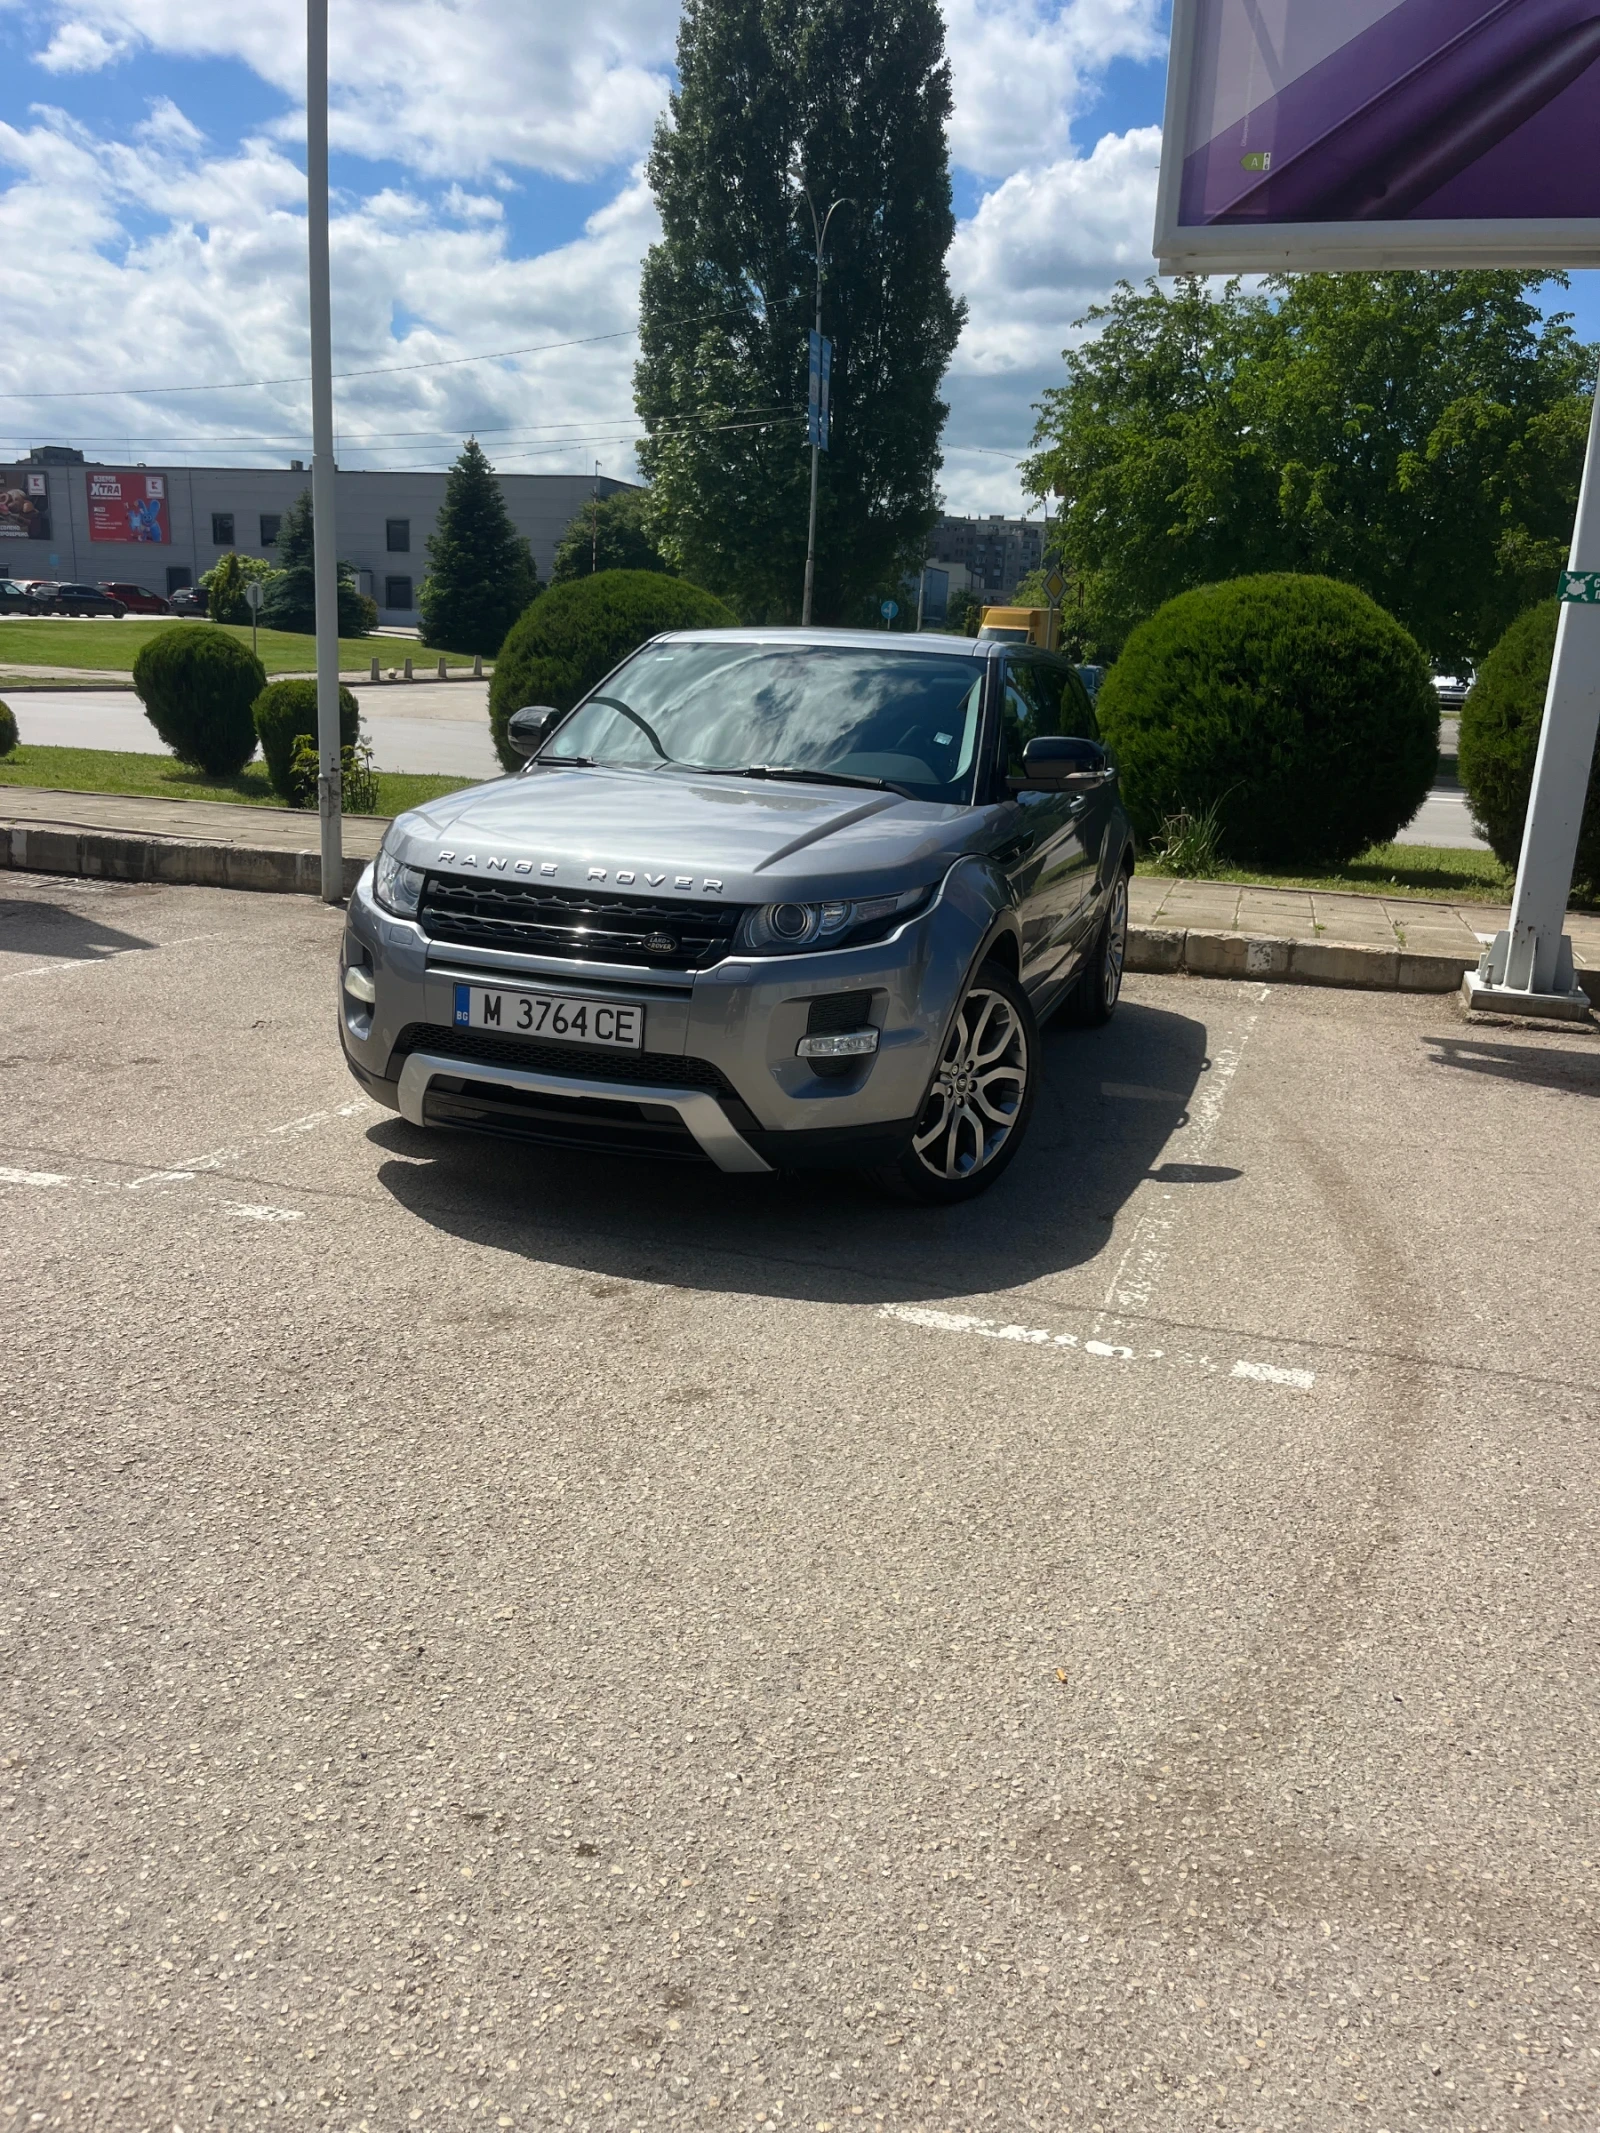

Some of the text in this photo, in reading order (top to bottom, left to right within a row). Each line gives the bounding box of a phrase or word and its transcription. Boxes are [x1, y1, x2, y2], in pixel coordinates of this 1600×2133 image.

[1251, 157, 1258, 167] A
[438, 850, 724, 894] RANGE ROVER
[456, 1010, 468, 1021] BG
